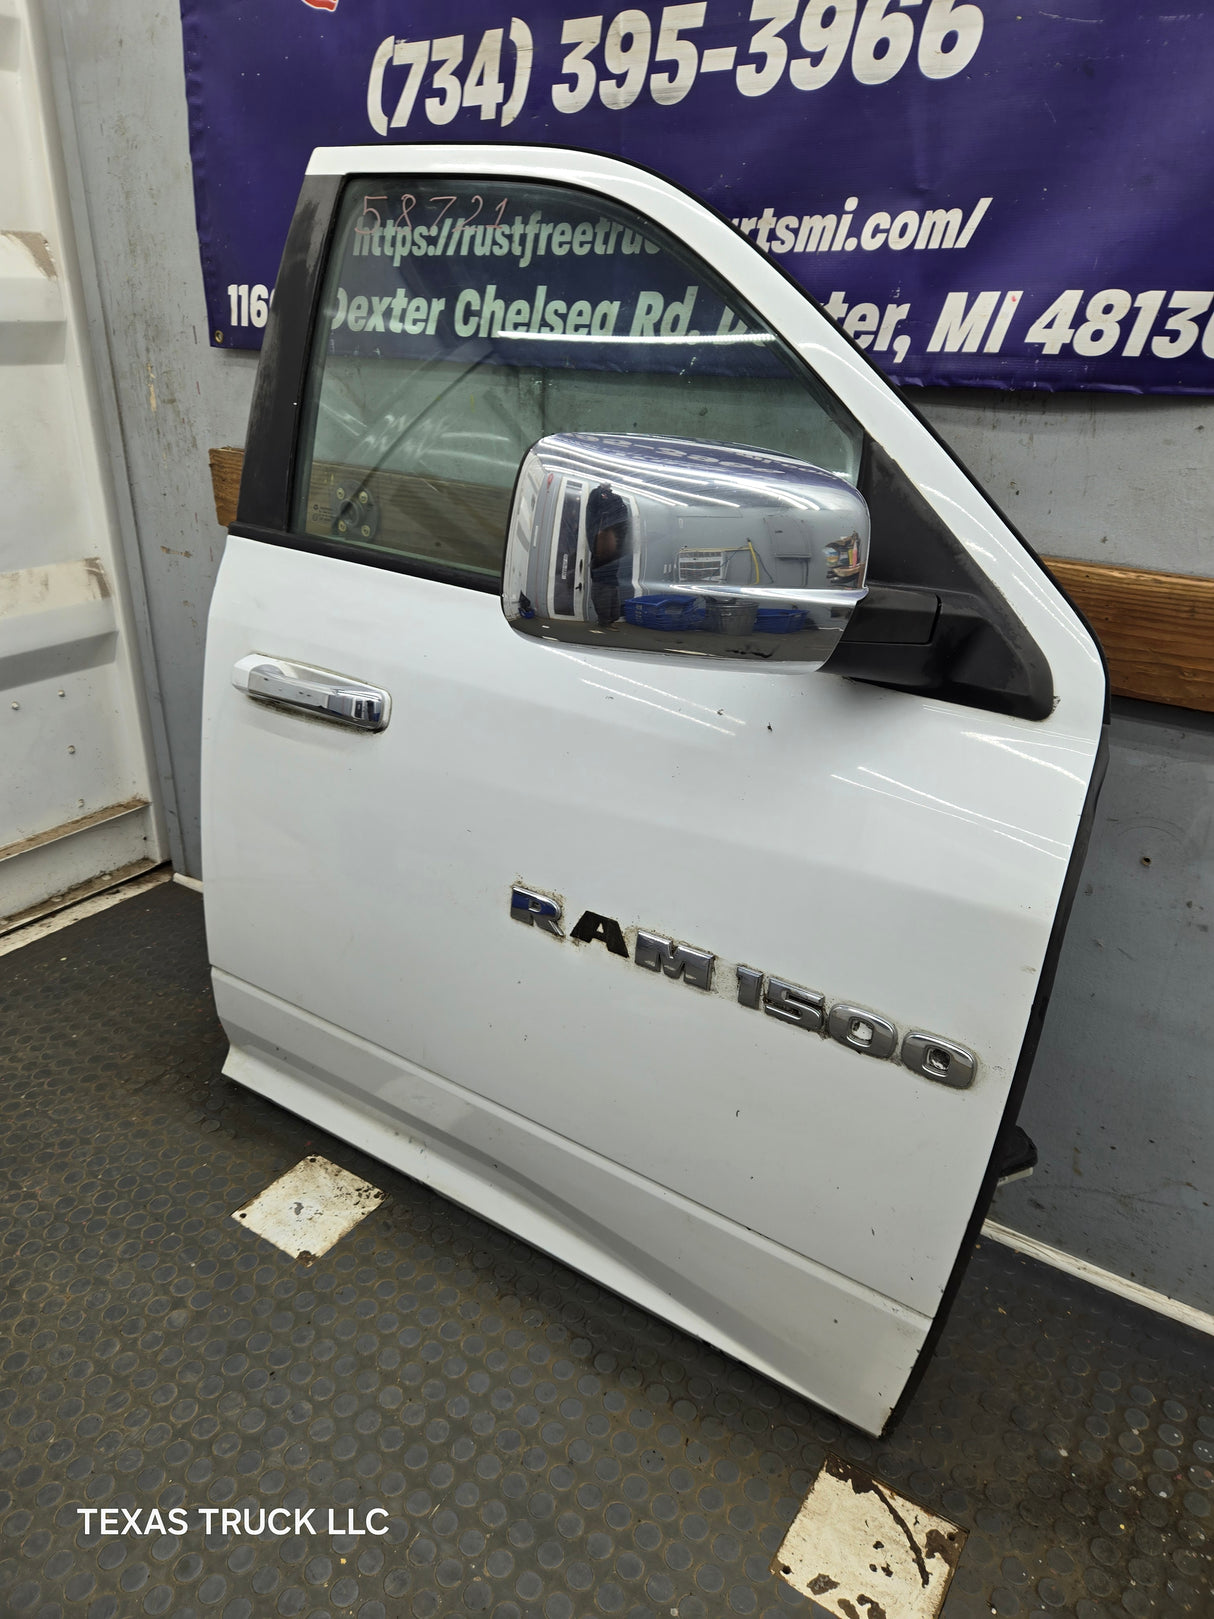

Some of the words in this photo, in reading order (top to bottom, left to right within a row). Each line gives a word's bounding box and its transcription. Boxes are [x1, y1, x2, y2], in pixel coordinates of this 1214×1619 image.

[367, 17, 533, 136] (734)
[551, 0, 985, 114] 395-3966
[454, 284, 621, 341] Chelsea
[630, 286, 701, 345] Rd.
[926, 290, 1024, 354] MI
[510, 884, 715, 992] RAM
[736, 964, 978, 1090] 1500
